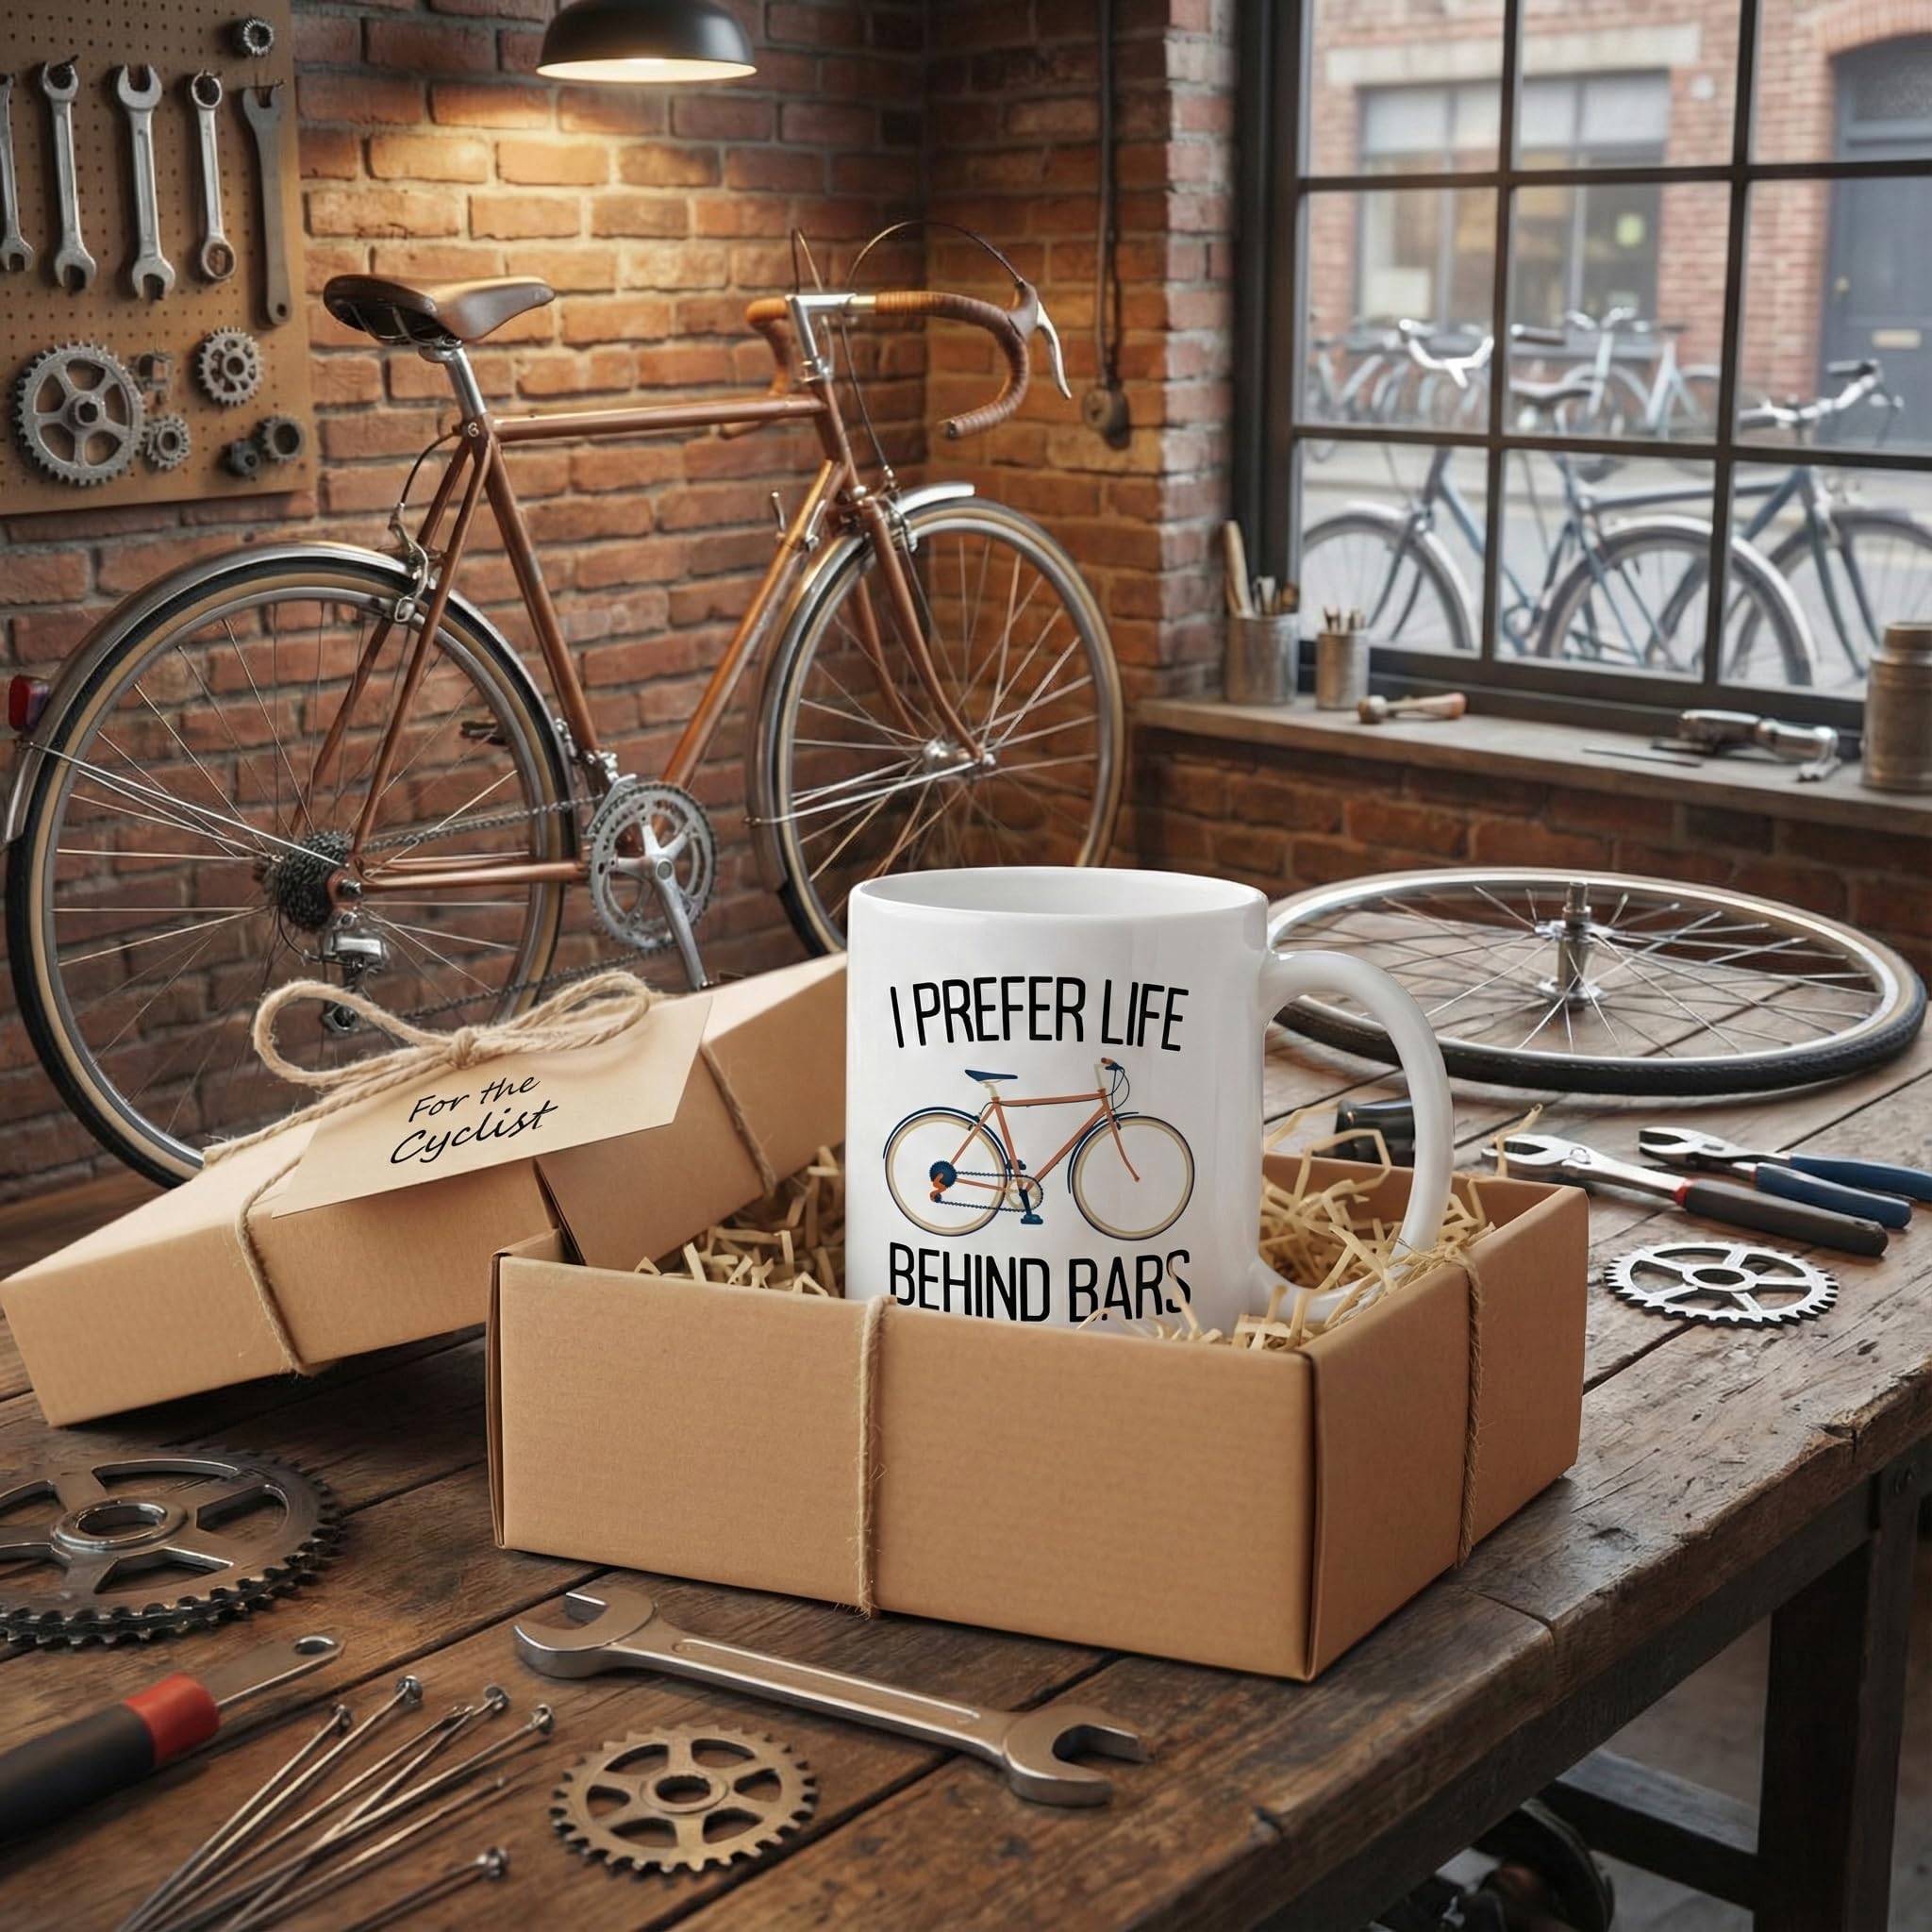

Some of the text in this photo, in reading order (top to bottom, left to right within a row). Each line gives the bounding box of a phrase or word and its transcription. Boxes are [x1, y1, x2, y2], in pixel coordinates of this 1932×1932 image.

[890, 975, 1190, 1052] I PREFER LIFE
[390, 1100, 559, 1164] Cyclist
[408, 1076, 541, 1123] For the
[889, 1241, 1191, 1323] BEHIND BARS
